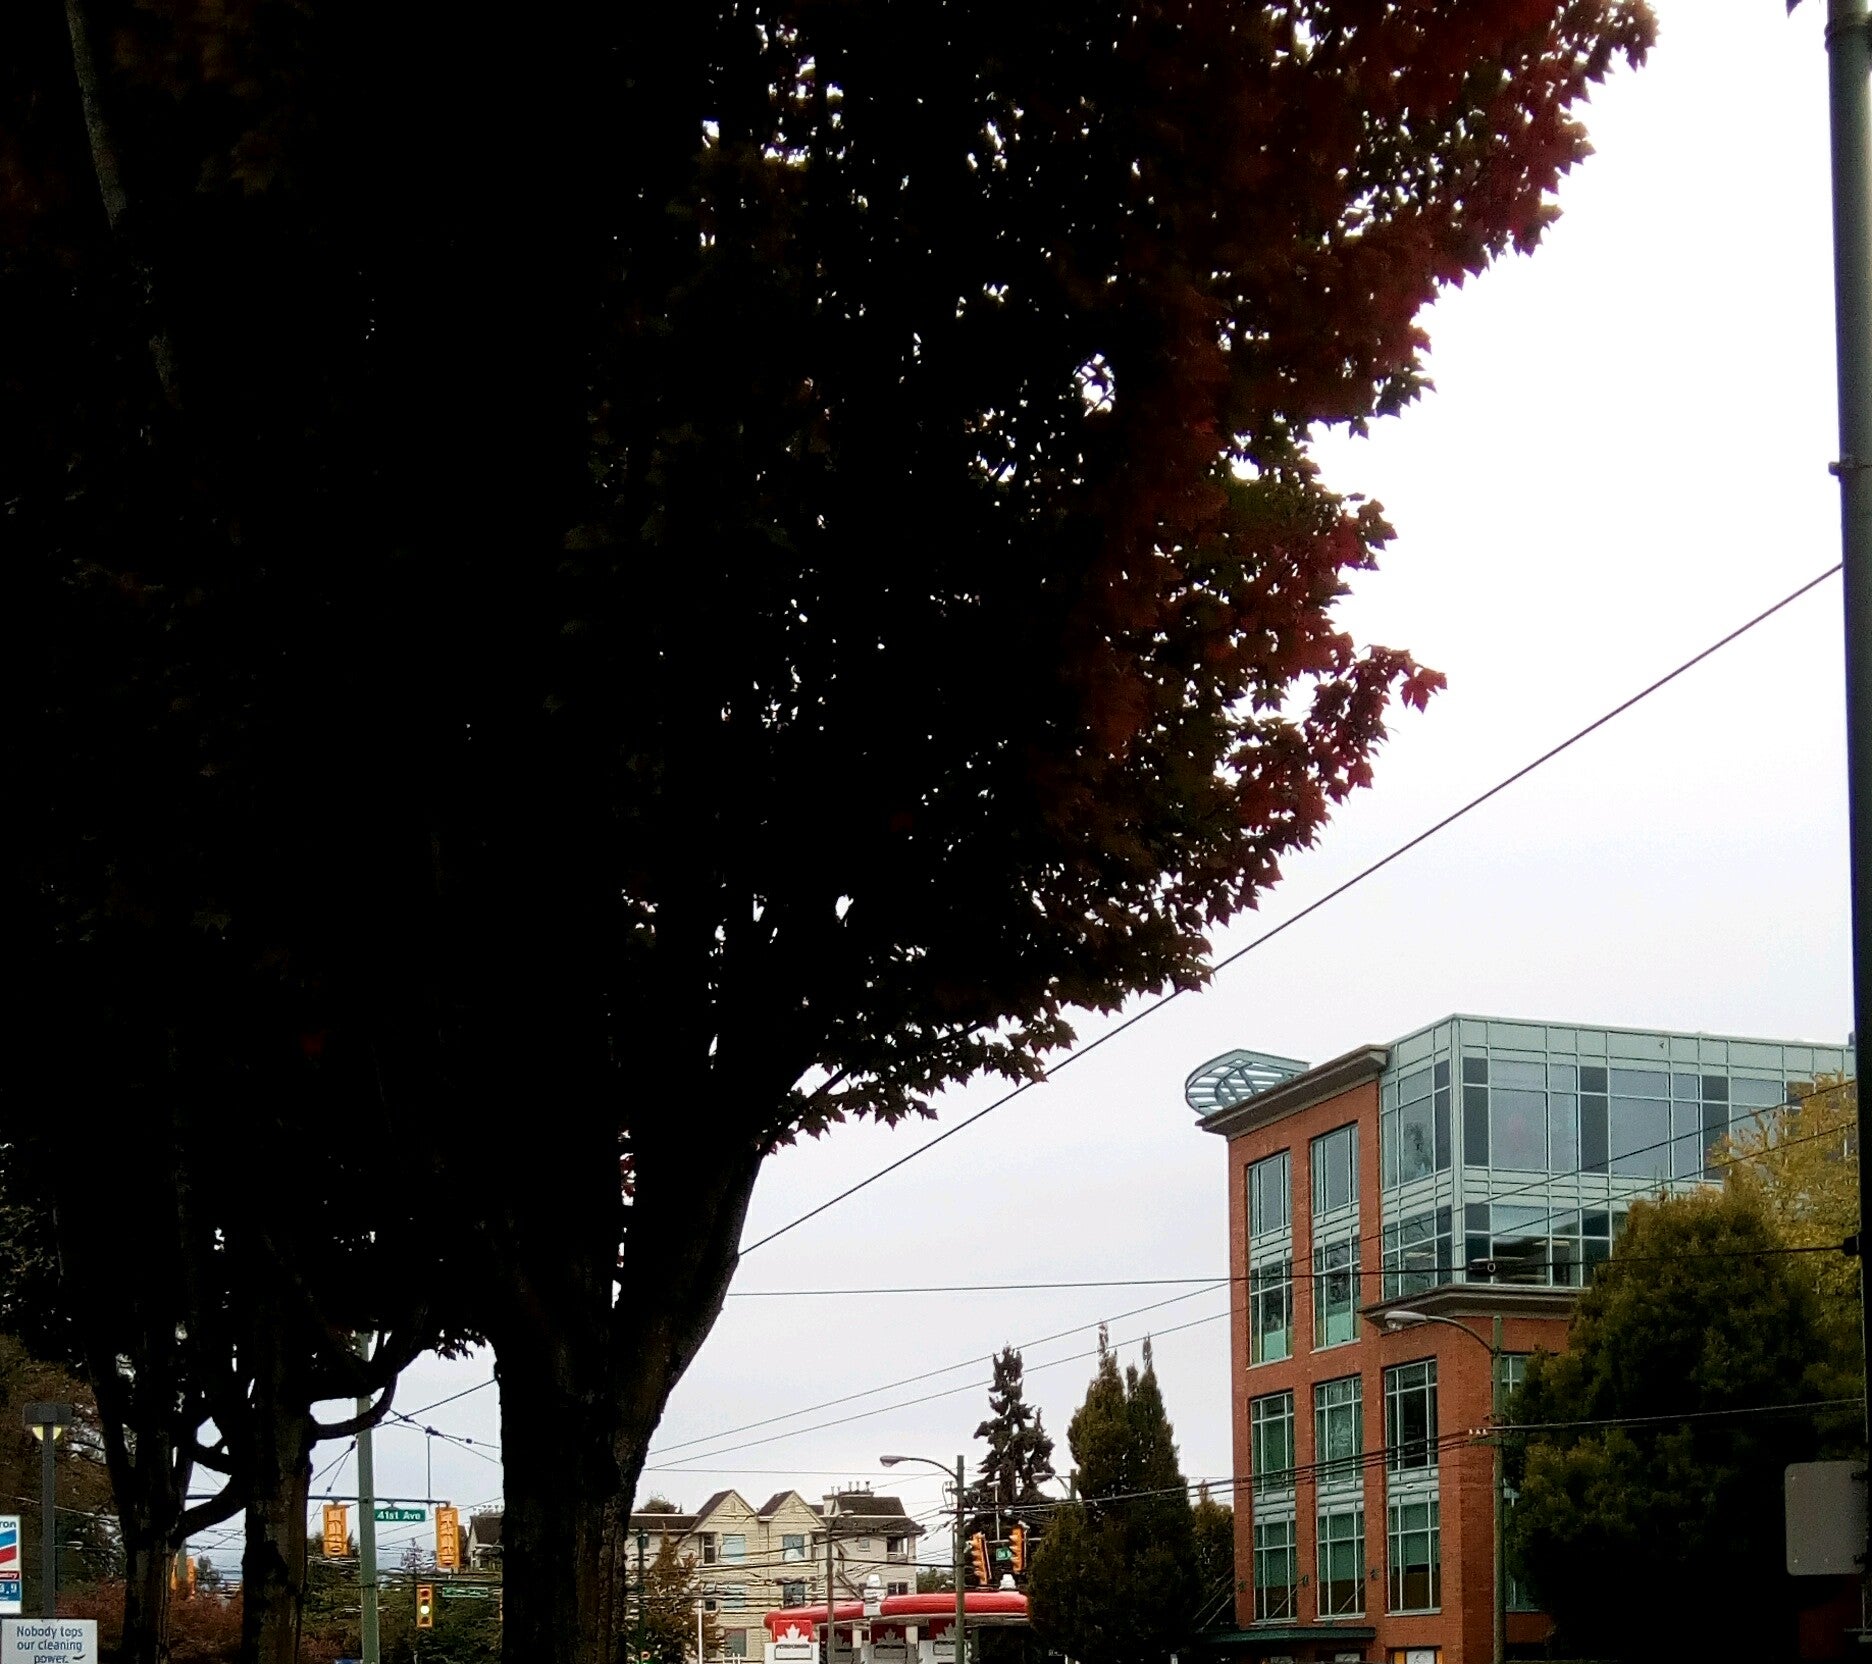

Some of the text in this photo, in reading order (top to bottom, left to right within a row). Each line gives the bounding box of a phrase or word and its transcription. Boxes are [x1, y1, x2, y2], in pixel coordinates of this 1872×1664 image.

[377, 1511, 421, 1520] 41st Ave
[16, 1625, 83, 1639] Nobody tops
[17, 1639, 83, 1653] our cleaning
[34, 1655, 69, 1664] power.
